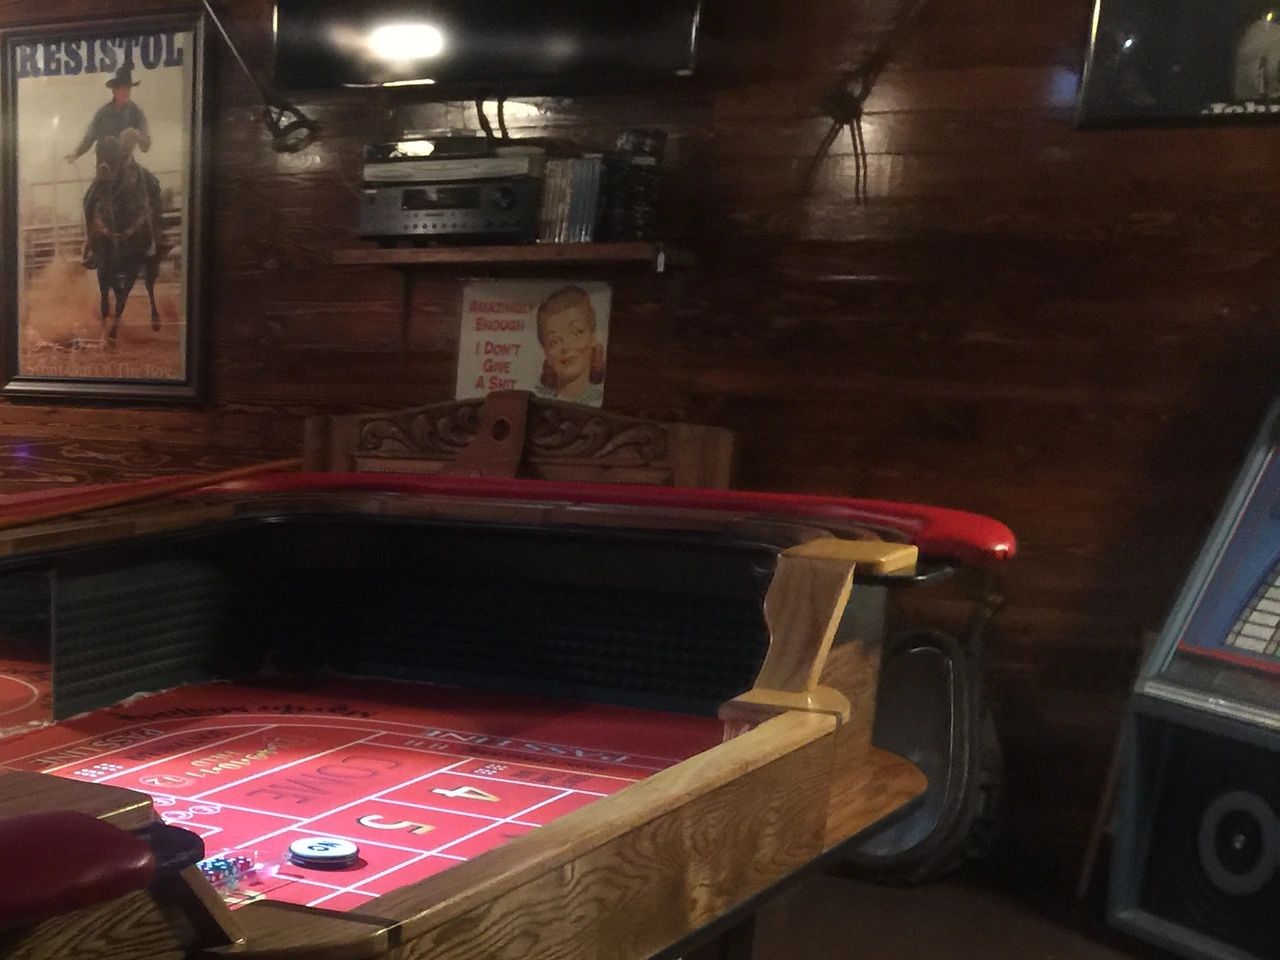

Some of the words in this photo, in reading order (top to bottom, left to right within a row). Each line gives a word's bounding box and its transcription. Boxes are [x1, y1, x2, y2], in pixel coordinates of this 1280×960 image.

[16, 33, 183, 78] RESISTOL
[475, 318, 525, 332] ENOUGH
[484, 359, 511, 374] GIVE
[475, 375, 485, 390] A
[246, 756, 400, 804] COME
[431, 786, 502, 802] 4
[356, 814, 436, 835] 5
